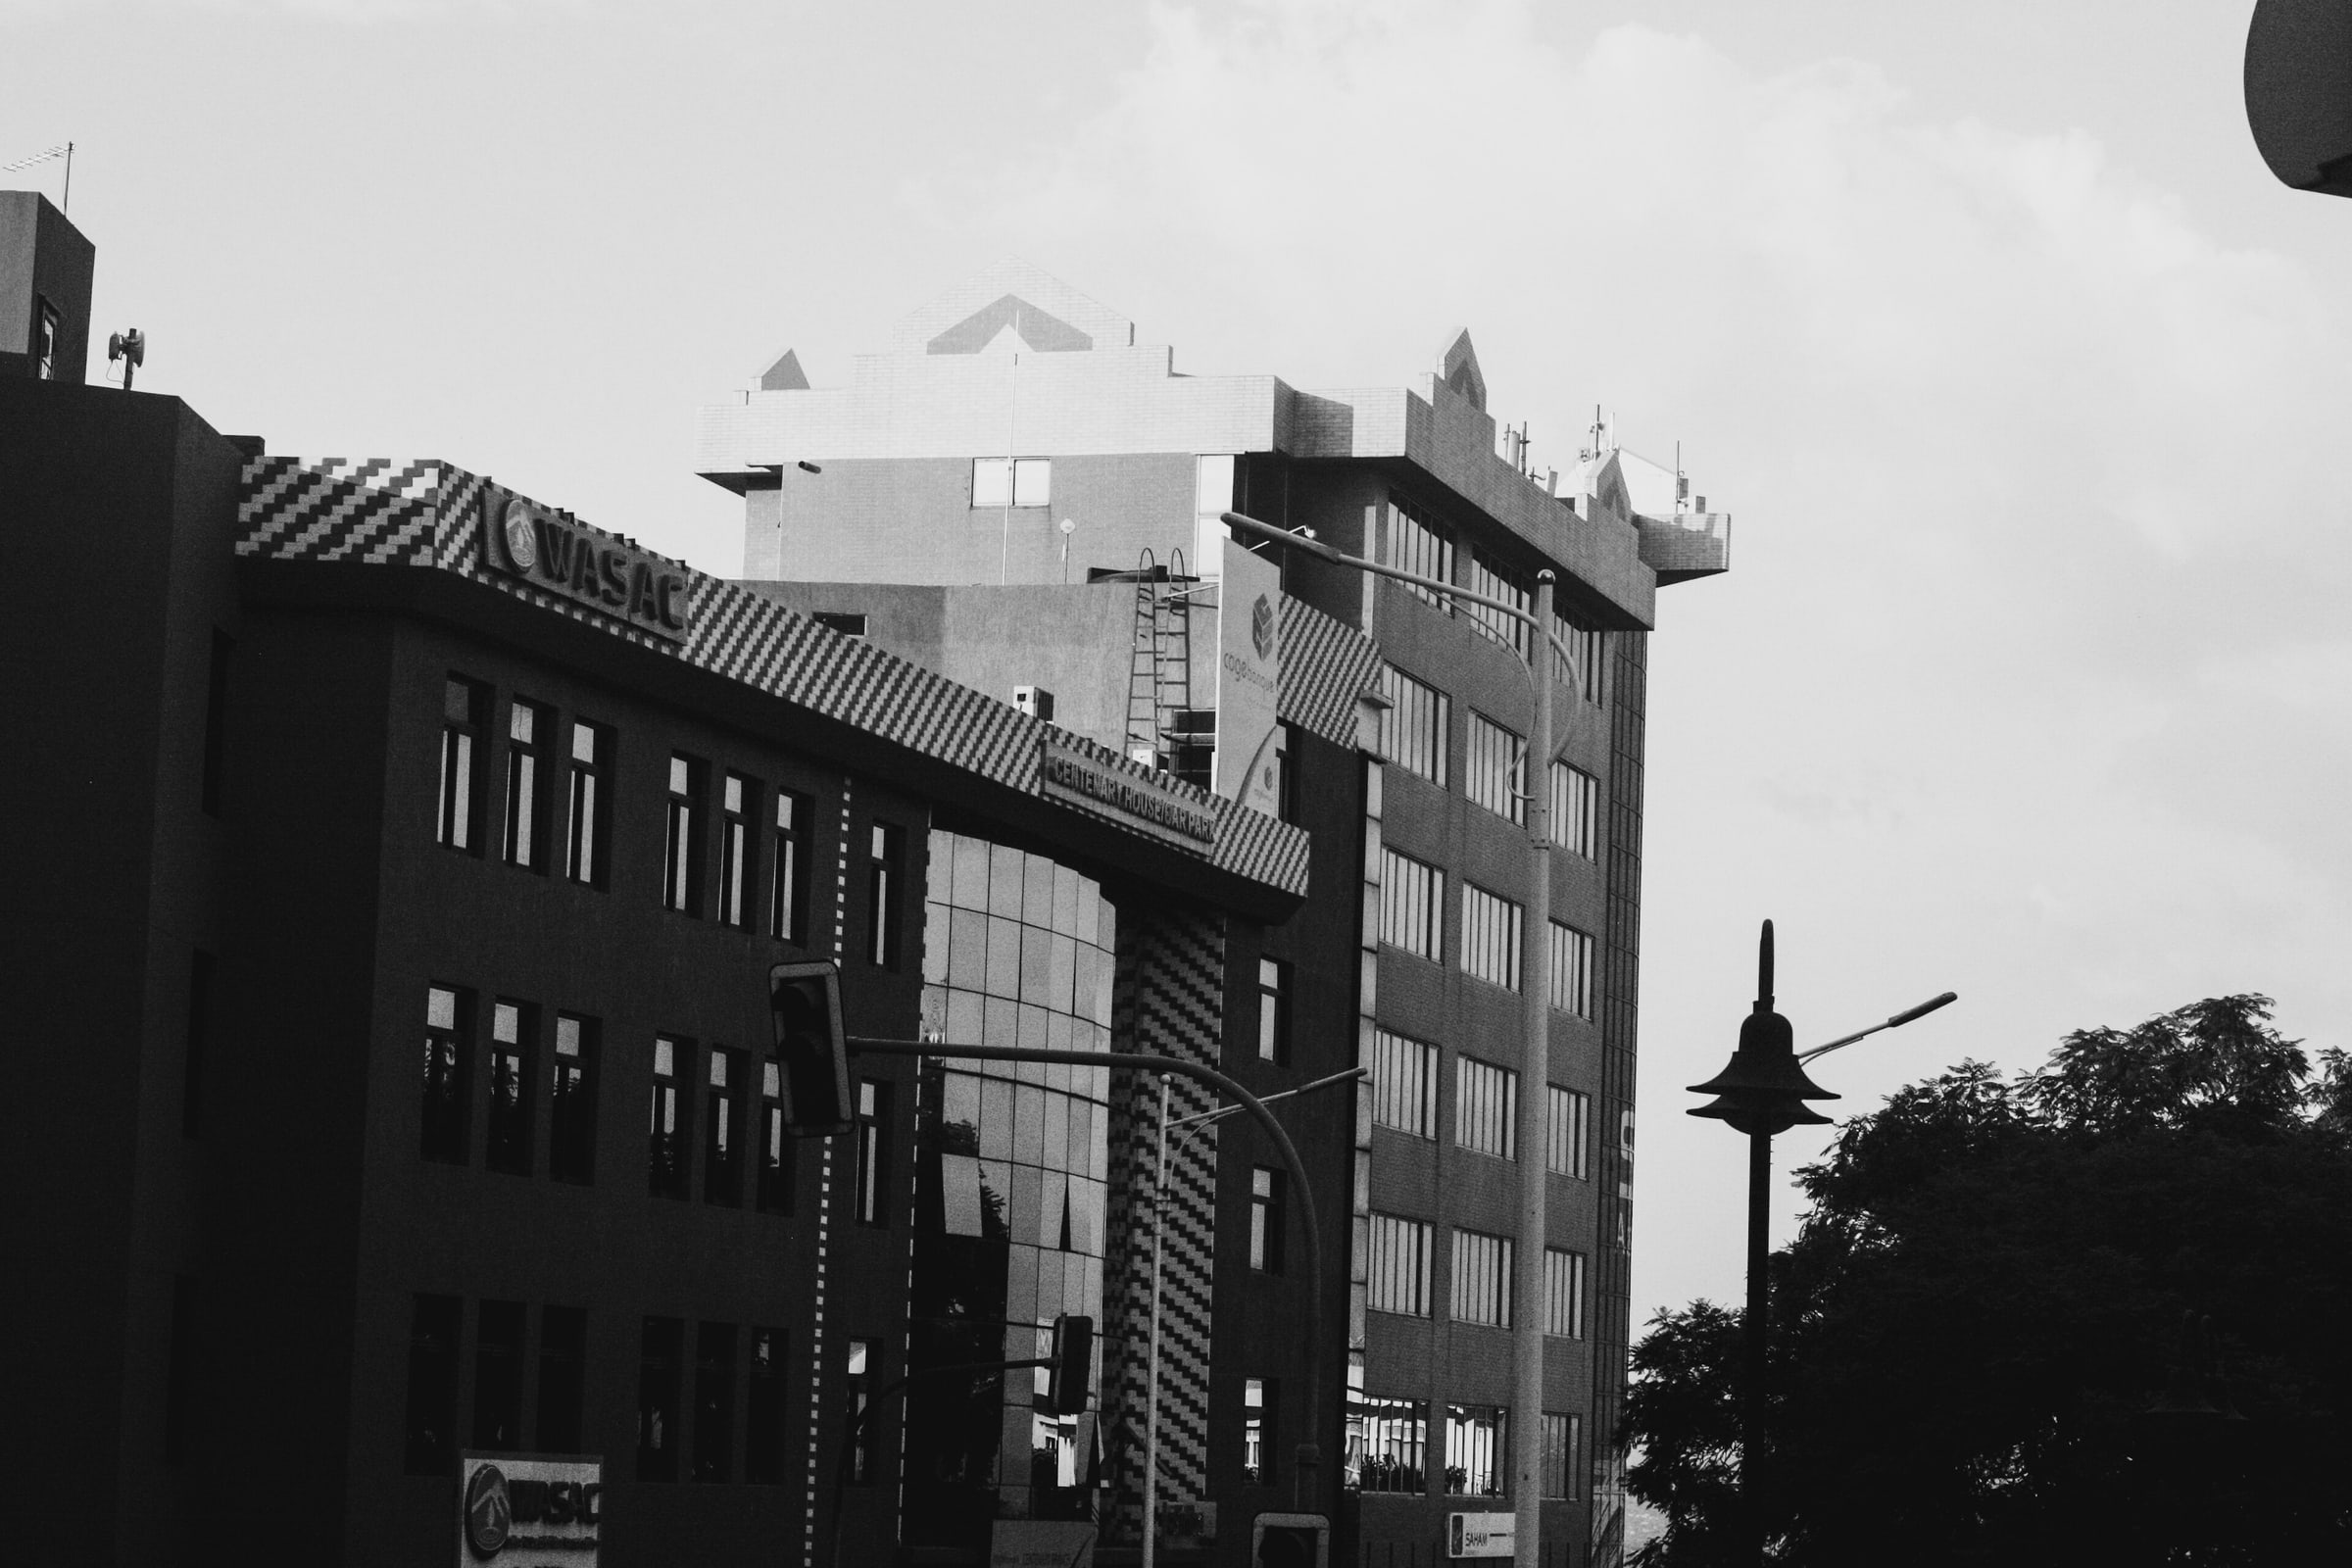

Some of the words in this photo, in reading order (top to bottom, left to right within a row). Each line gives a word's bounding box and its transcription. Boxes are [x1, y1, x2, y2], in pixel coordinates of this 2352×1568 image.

[533, 518, 683, 630] WASAC
[1054, 756, 1125, 808] CENTENARY
[1188, 813, 1216, 841] PARK
